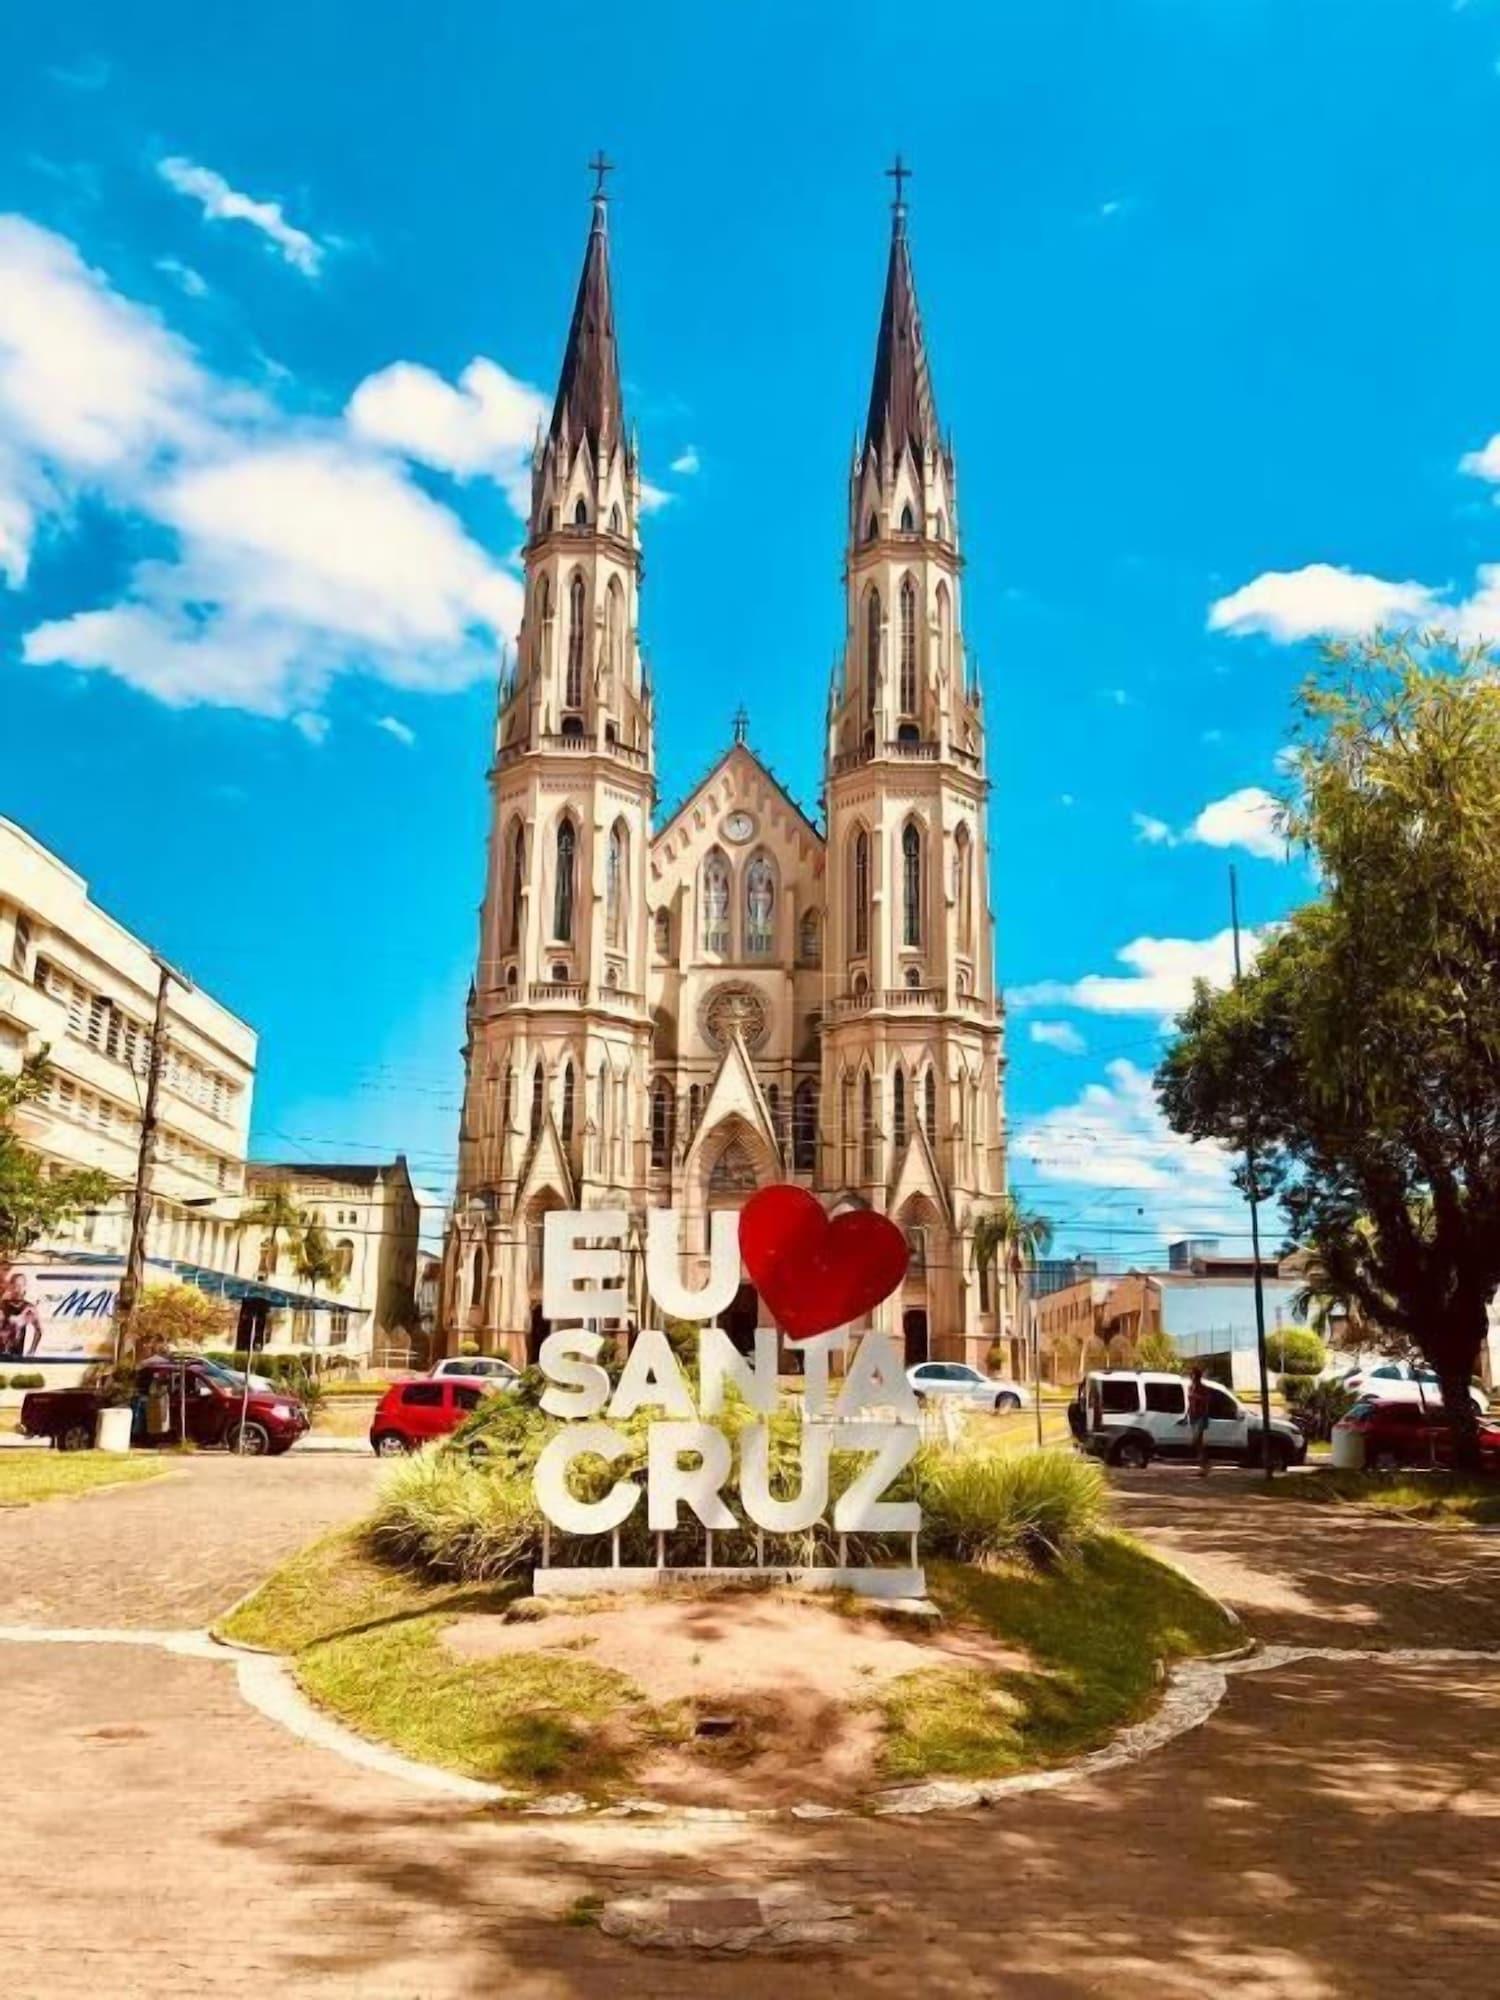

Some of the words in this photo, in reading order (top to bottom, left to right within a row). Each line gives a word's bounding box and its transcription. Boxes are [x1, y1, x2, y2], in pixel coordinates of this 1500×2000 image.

[543, 1208, 741, 1319] EU
[538, 1328, 919, 1418] SANTA
[533, 1422, 921, 1534] CRUZ
